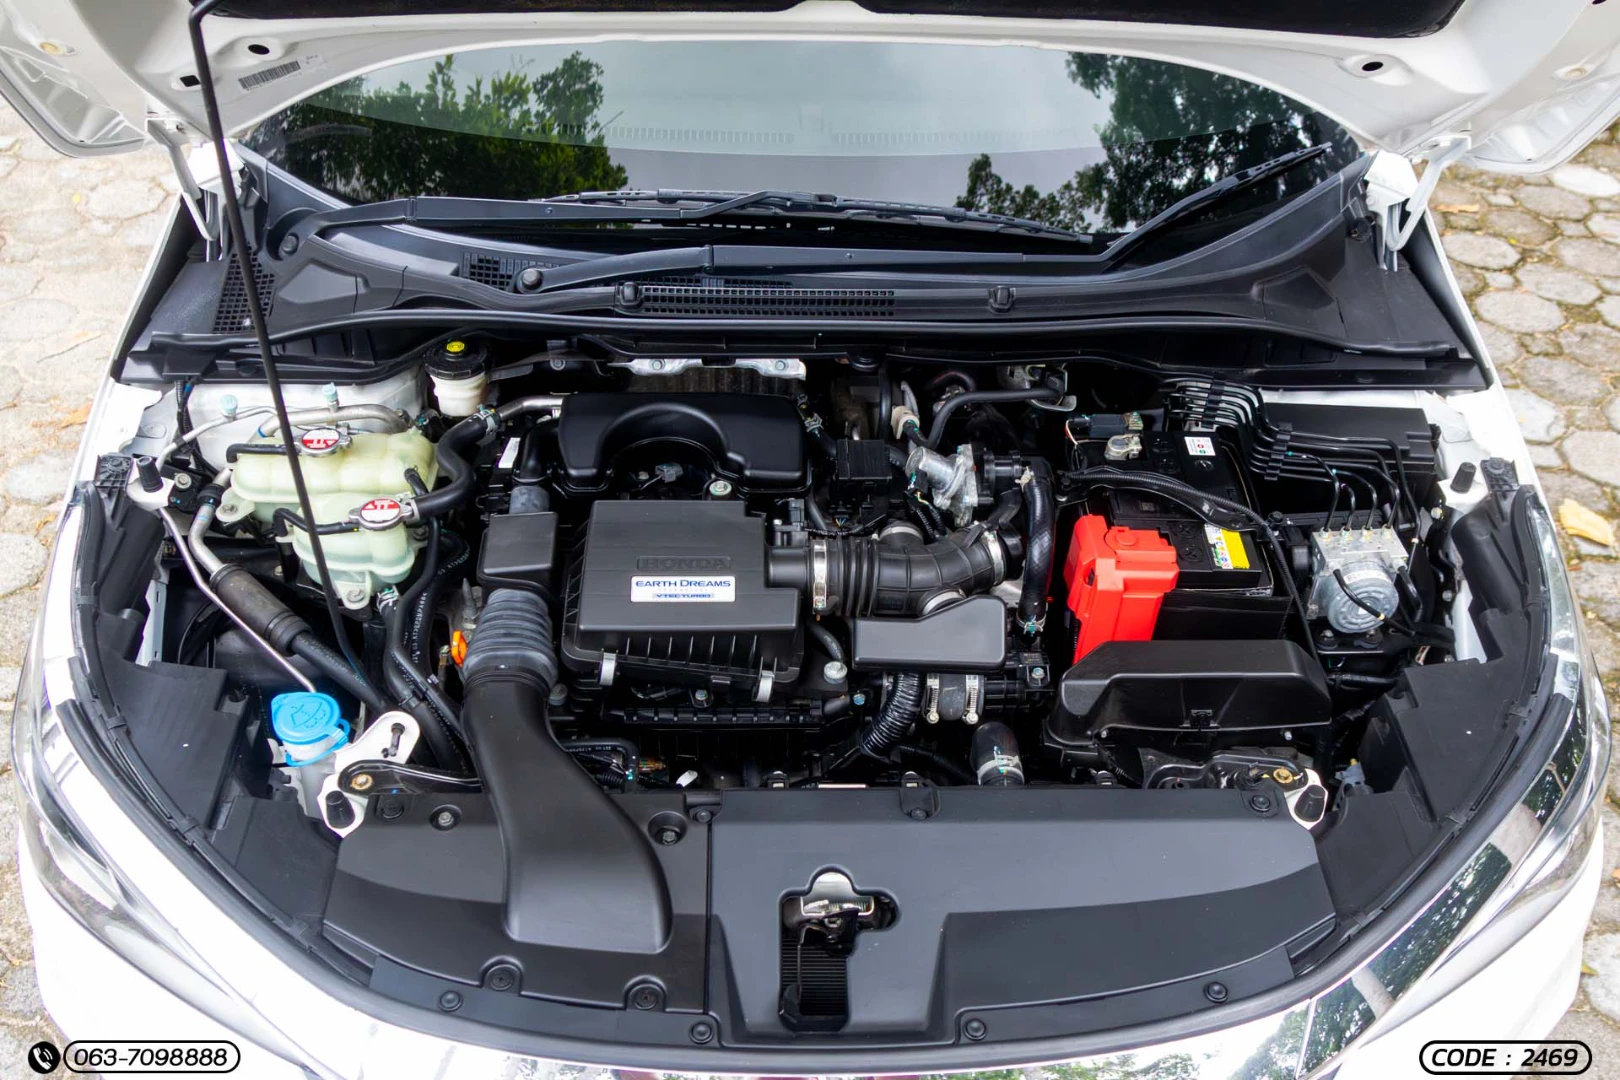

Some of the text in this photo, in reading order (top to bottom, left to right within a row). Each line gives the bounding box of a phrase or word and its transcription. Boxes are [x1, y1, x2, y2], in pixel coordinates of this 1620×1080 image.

[644, 558, 728, 570] HONDA
[635, 579, 731, 588] EARTH DREAMS
